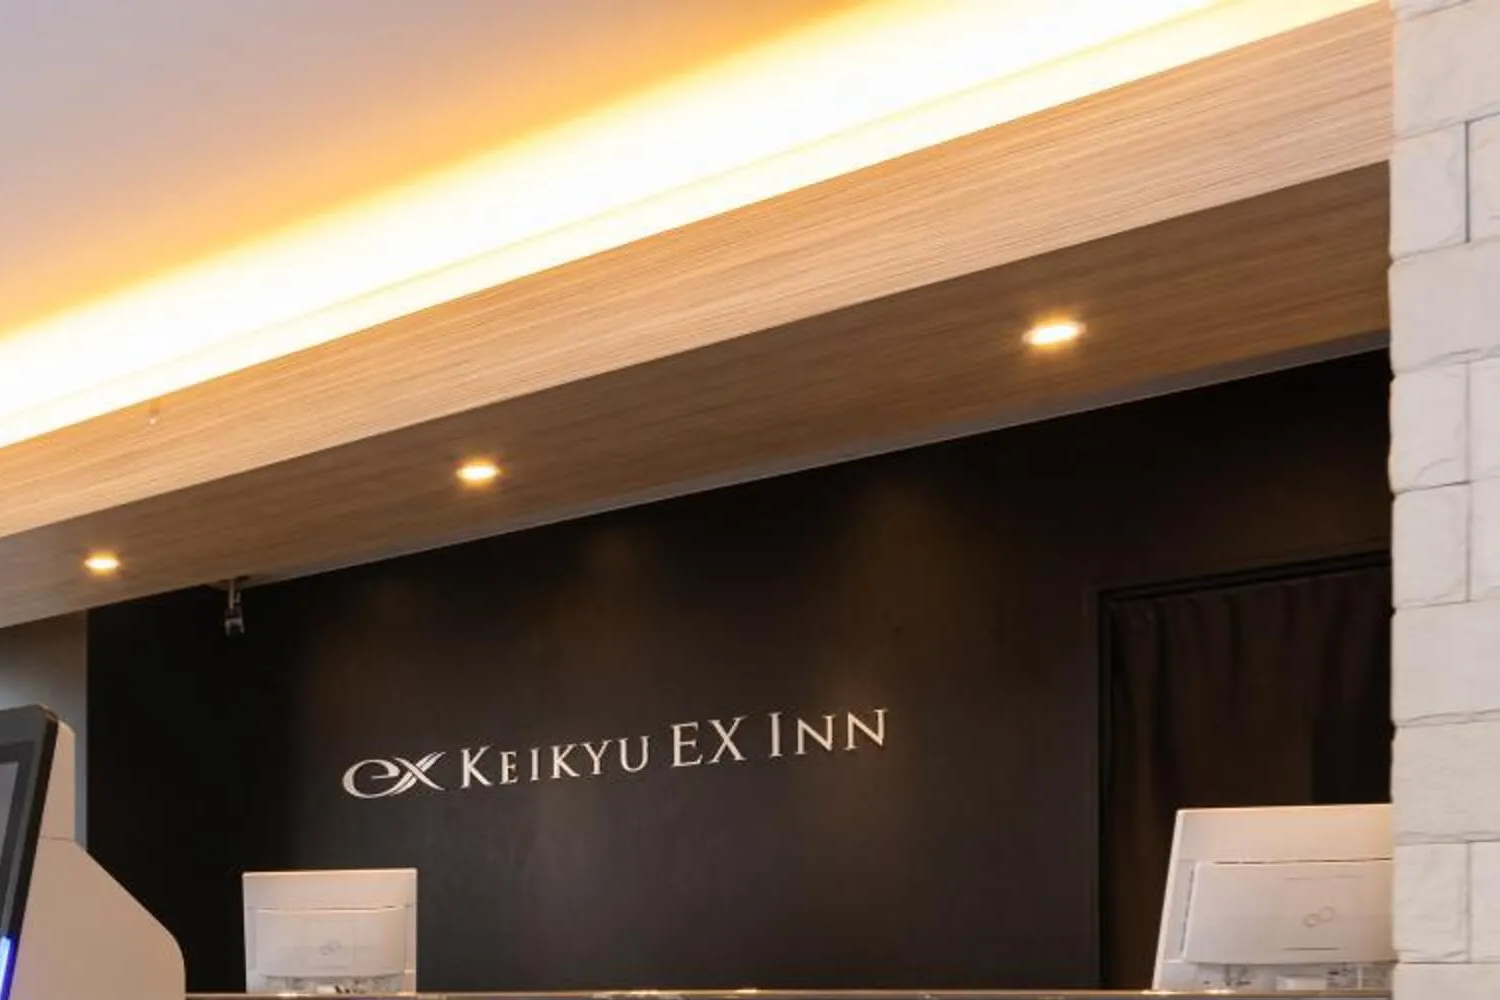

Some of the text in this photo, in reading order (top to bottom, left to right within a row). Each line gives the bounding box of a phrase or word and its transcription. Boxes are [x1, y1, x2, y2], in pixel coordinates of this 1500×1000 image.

[460, 735, 649, 789] KEIKYU
[671, 717, 746, 768] EX
[770, 708, 886, 758] INN
